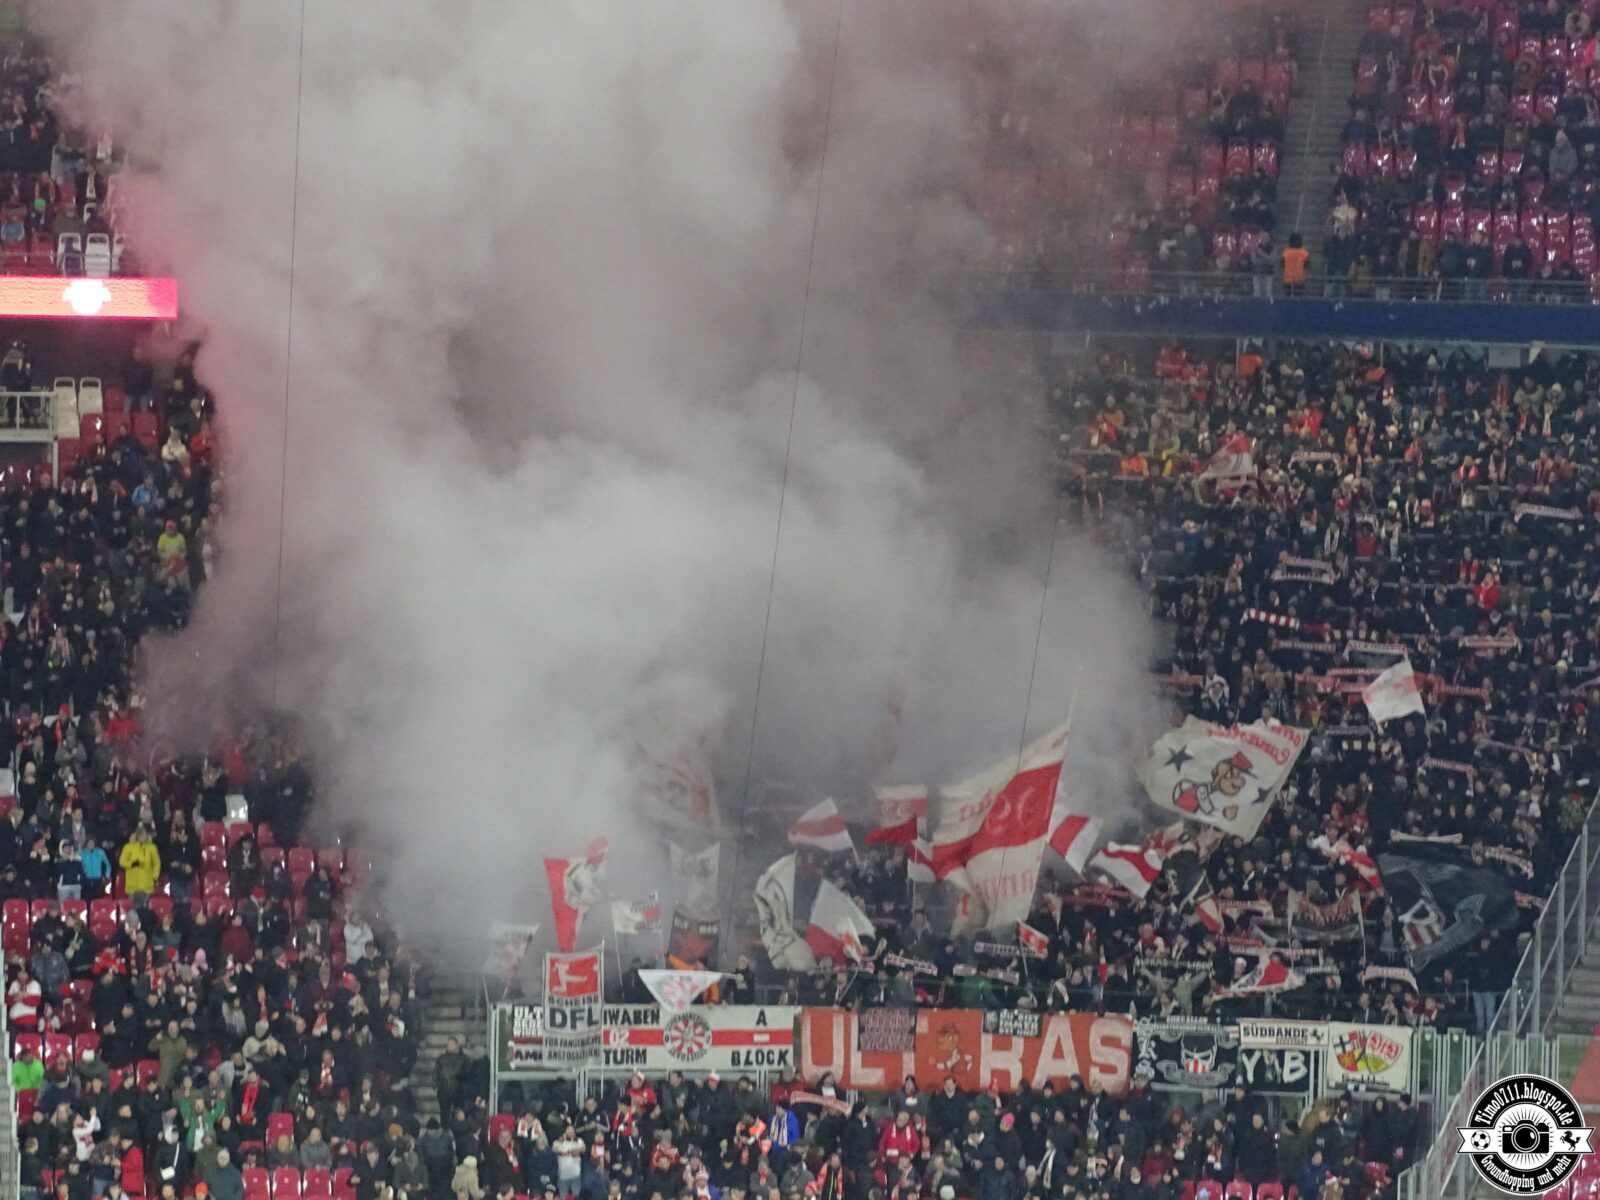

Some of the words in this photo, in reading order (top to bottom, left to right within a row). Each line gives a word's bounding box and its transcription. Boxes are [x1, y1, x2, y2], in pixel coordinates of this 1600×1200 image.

[549, 1007, 599, 1030] DFL
[756, 1009, 768, 1027] A
[1243, 1023, 1308, 1038] SÜDBANDE
[731, 1050, 789, 1067] BLOCK
